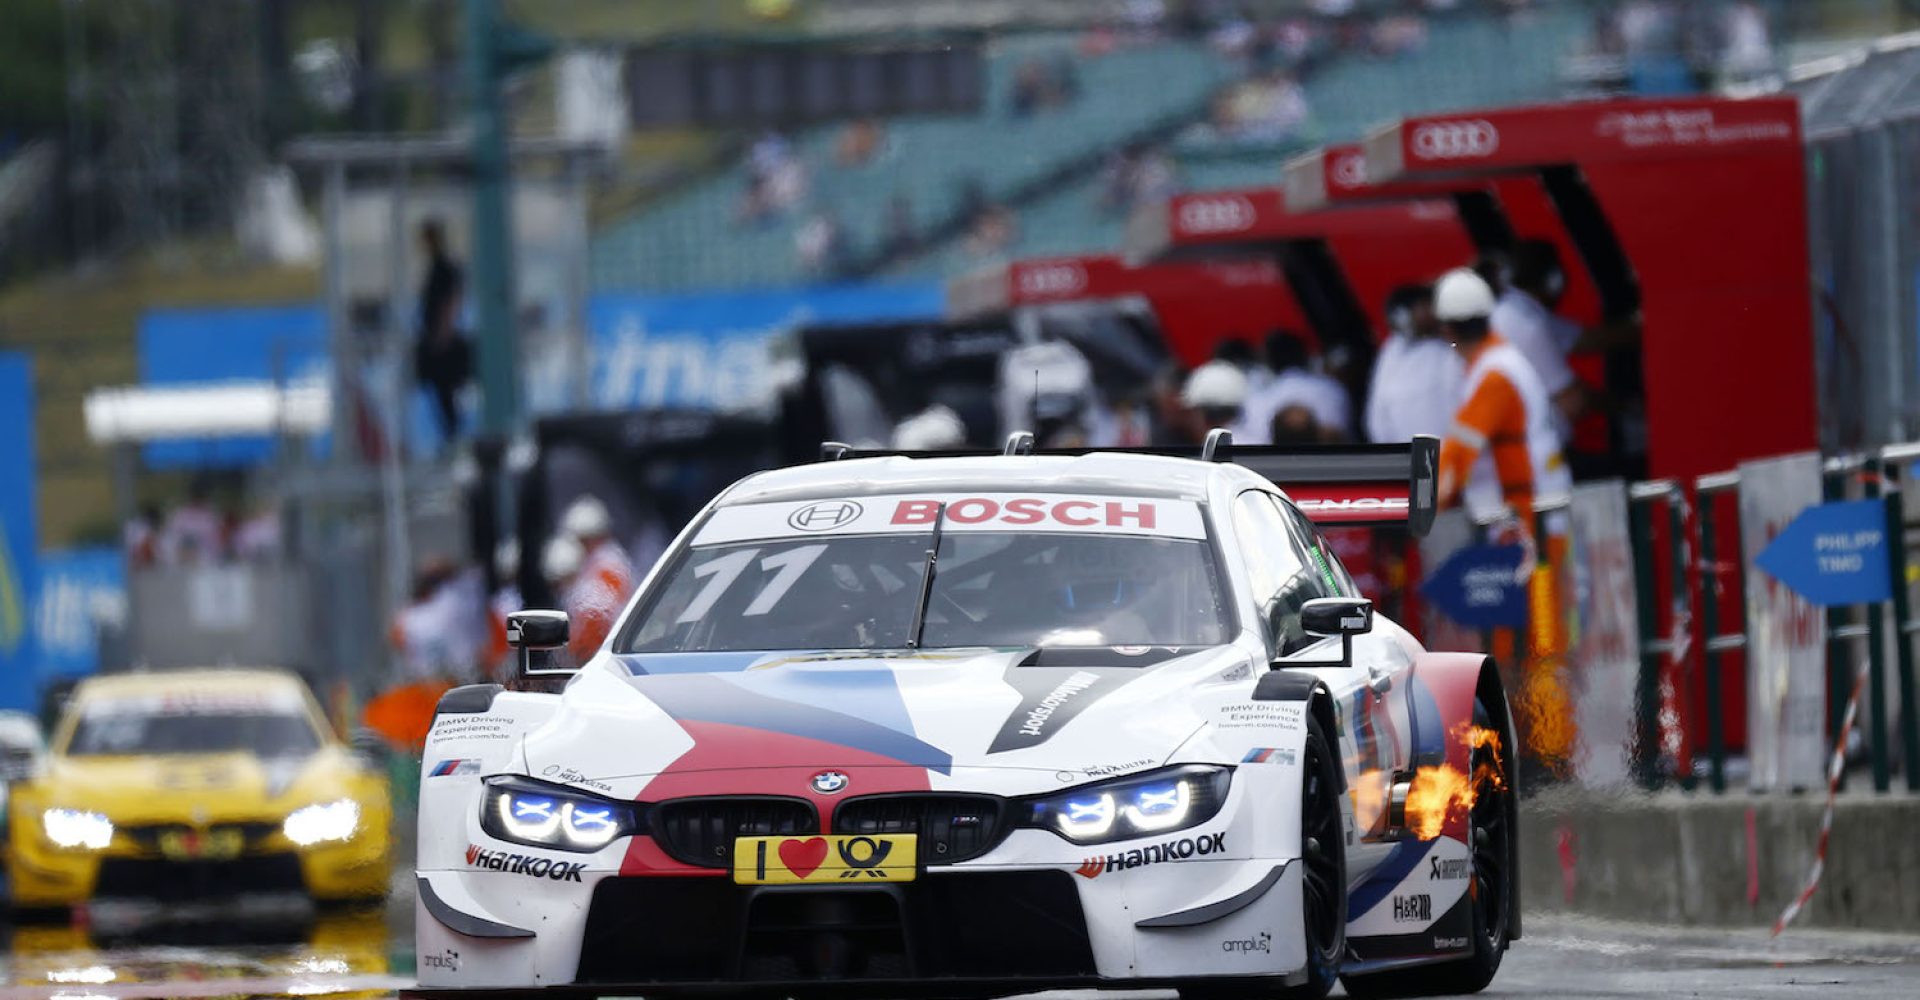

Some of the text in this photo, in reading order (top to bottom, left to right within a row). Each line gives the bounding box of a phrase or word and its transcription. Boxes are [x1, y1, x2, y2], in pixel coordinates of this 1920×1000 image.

[889, 498, 1156, 529] BOSCH
[676, 544, 829, 624] 11
[1221, 704, 1300, 716] BMW Driving
[1230, 713, 1299, 723] Experience
[437, 716, 514, 728] BMW Driving
[434, 725, 501, 737] Experience
[757, 840, 767, 881] I
[1222, 936, 1267, 956] amplus
